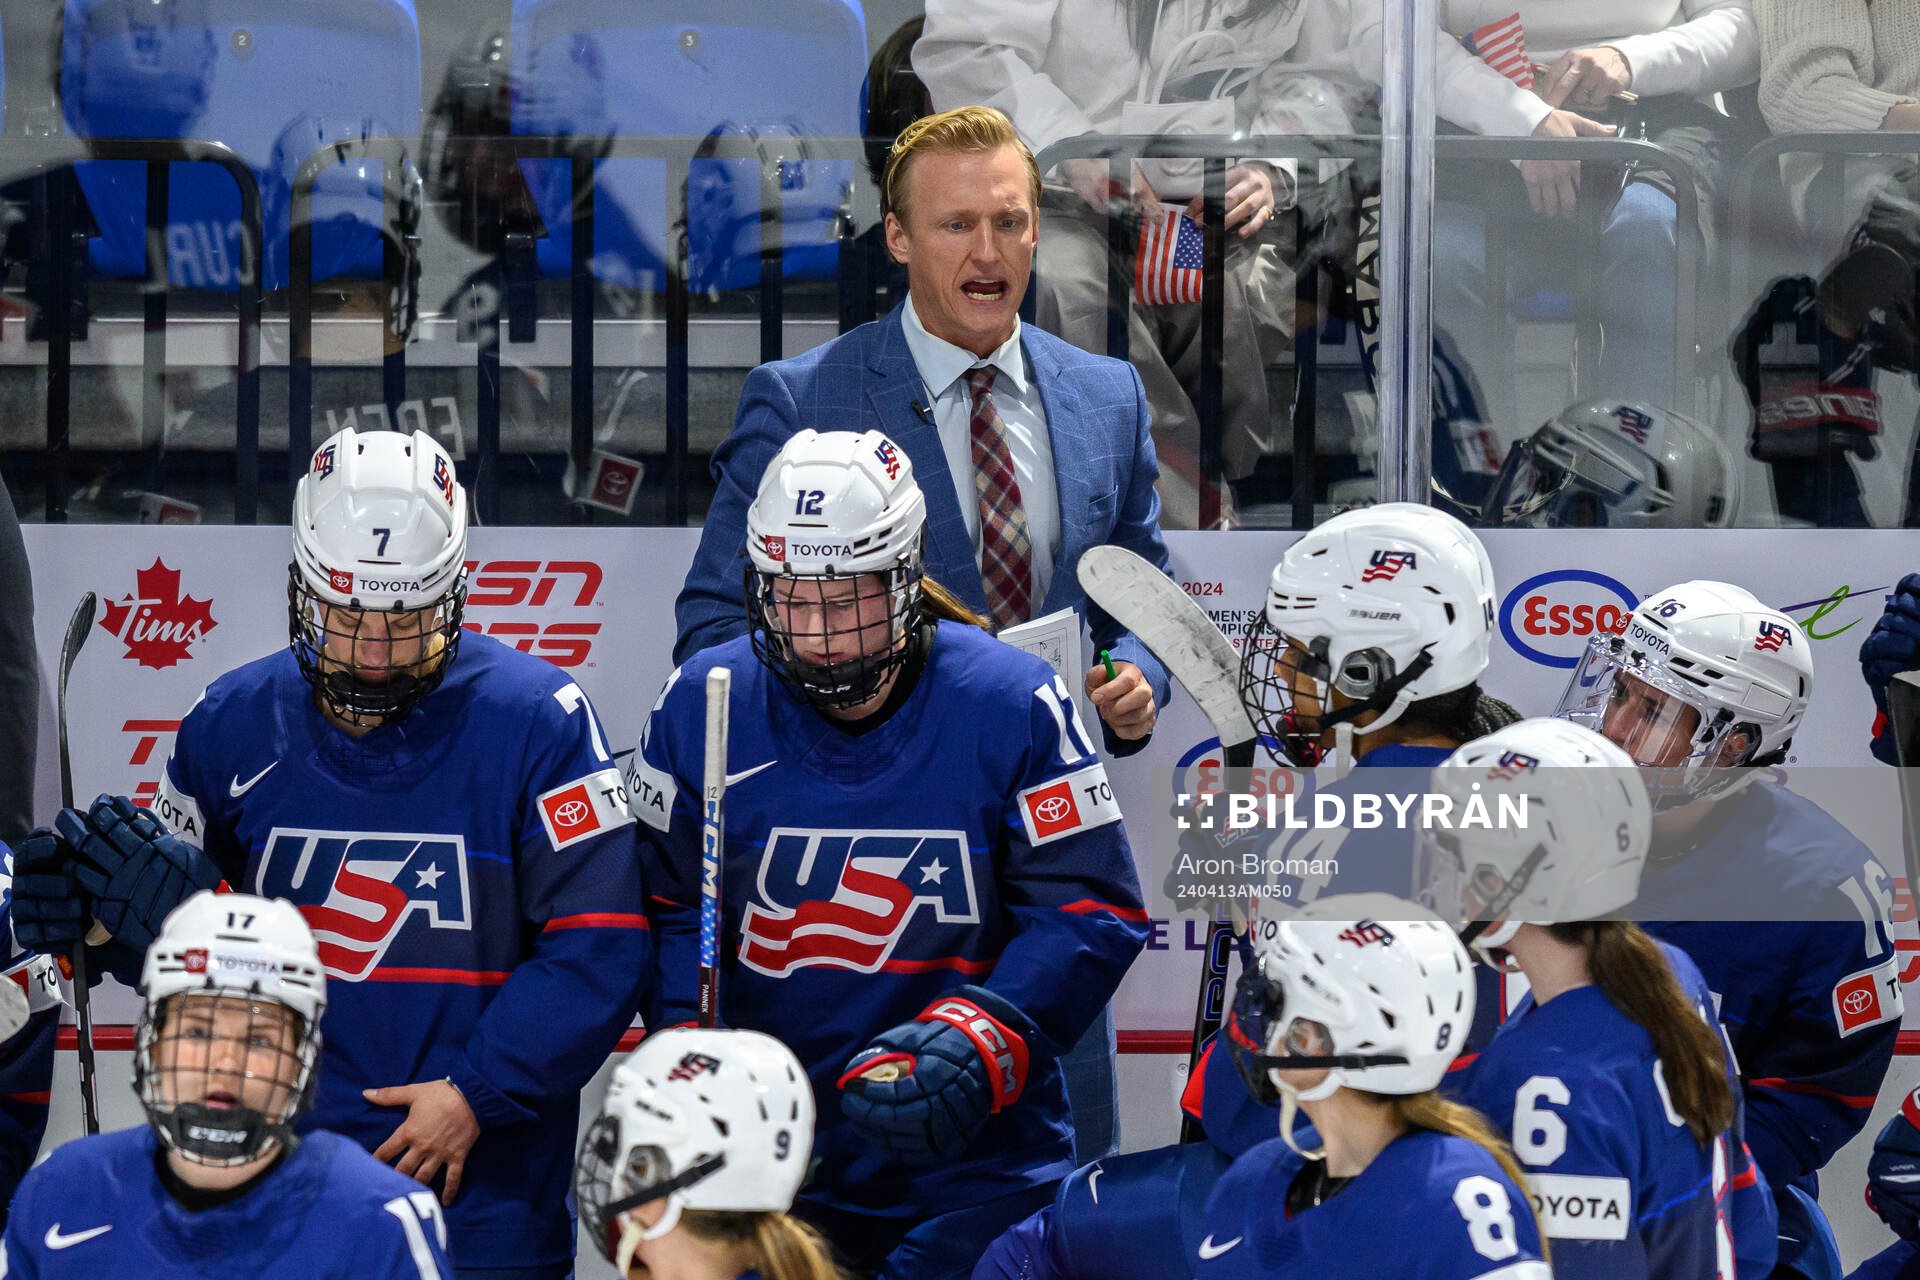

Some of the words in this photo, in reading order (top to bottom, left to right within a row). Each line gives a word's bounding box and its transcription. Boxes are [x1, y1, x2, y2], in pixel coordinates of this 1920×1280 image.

[796, 489, 826, 516] 12
[372, 528, 391, 557] 7
[792, 544, 852, 557] TOYOTA
[1361, 550, 1417, 583] USA
[360, 579, 420, 592] TOYOTA
[1182, 582, 1224, 596] 2024
[114, 598, 203, 645] Tims
[1523, 596, 1624, 636] Esso
[1630, 623, 1671, 656] TOYOTA
[1754, 620, 1793, 653] USA
[553, 682, 610, 762] 7
[706, 786, 718, 799] 12
[1084, 782, 1112, 806] TO
[702, 799, 720, 898] CCM
[1616, 822, 1631, 852] 6
[255, 827, 472, 983] USA
[737, 827, 981, 979] USA
[228, 913, 256, 929] 17
[217, 955, 280, 973] TOYOTA
[931, 1001, 1017, 1094] CCM
[1436, 1023, 1451, 1050] 8
[1512, 1075, 1571, 1167] 6
[773, 1129, 791, 1161] 9
[1453, 1175, 1518, 1261] 8
[383, 1191, 447, 1280] 17
